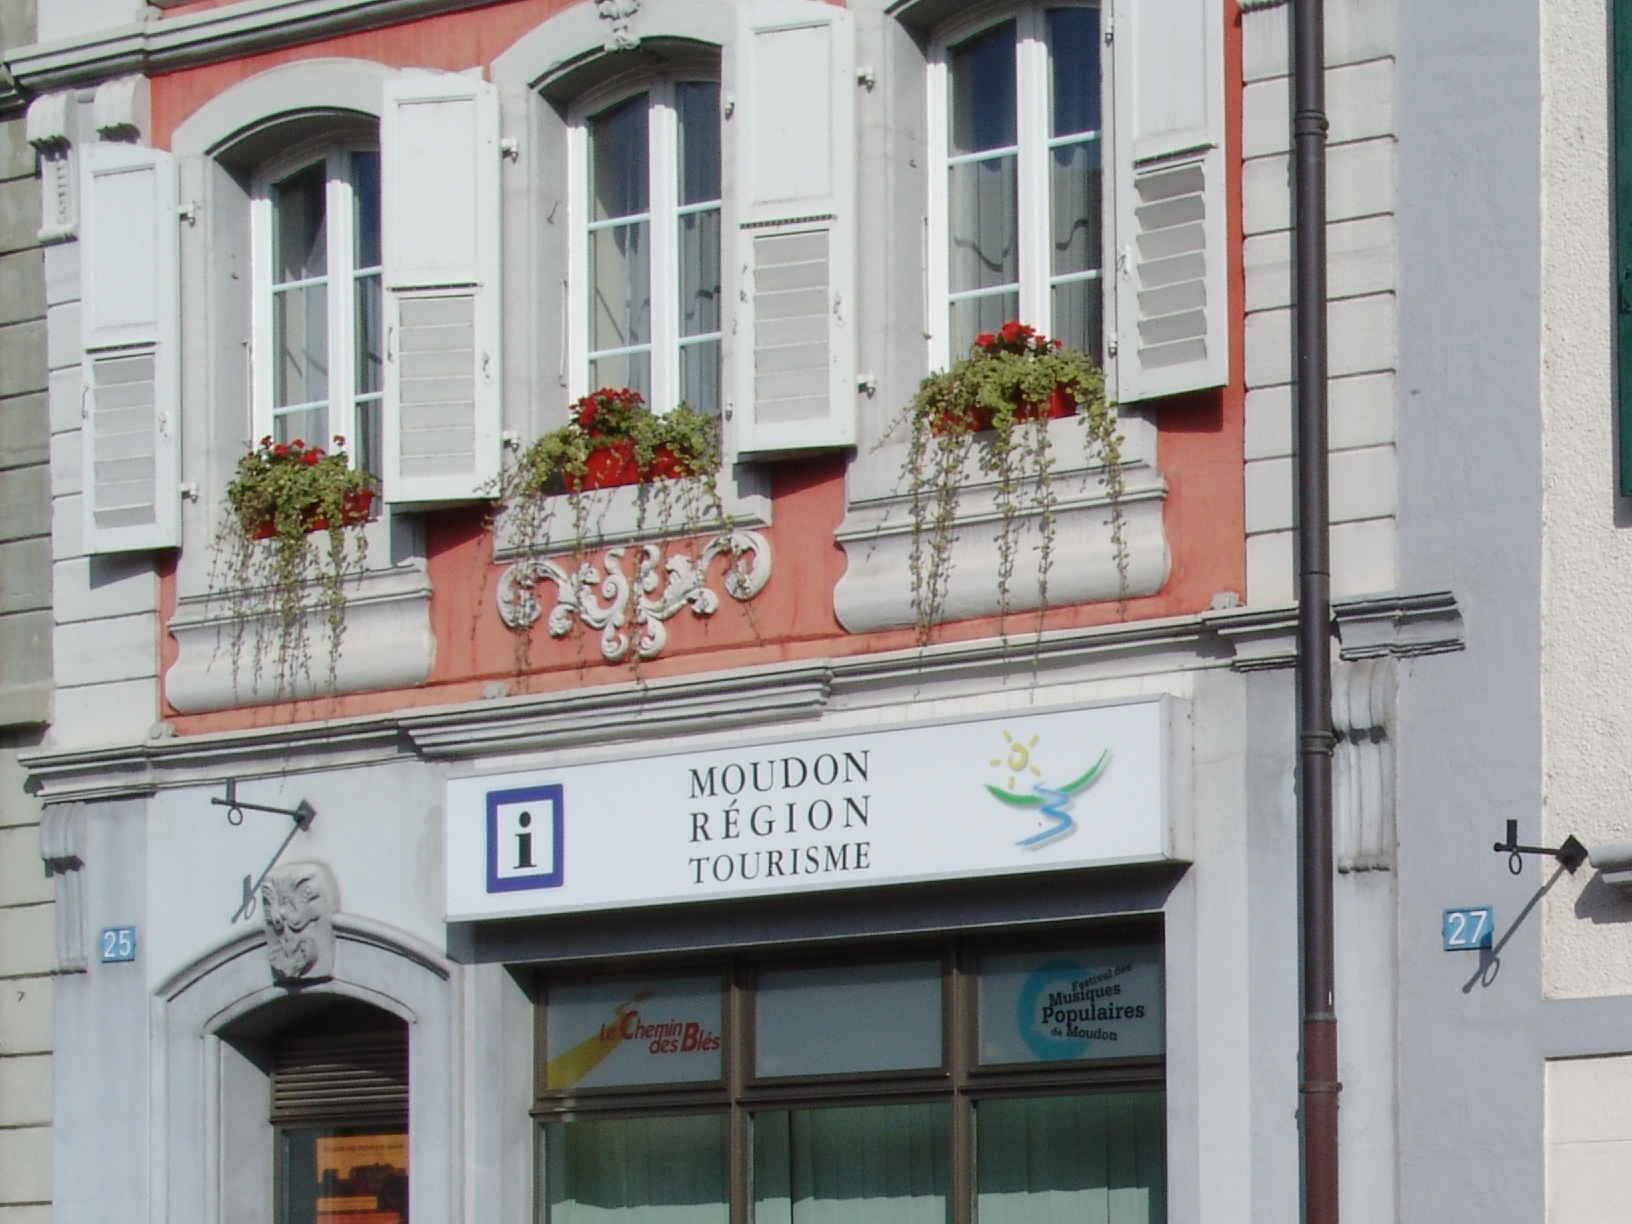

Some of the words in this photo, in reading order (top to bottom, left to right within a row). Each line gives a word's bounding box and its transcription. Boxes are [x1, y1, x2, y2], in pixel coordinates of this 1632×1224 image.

[688, 750, 870, 799] MOUDON
[689, 795, 871, 843] RÉGION
[513, 811, 537, 869] i
[688, 842, 870, 884] TOURISME
[1448, 910, 1487, 945] 27
[104, 930, 131, 957] 25
[1071, 969, 1112, 991] Festival
[1114, 964, 1132, 976] des
[1049, 983, 1121, 1006] Musiques
[599, 1023, 616, 1041] Le
[620, 1010, 683, 1039] Chemin
[1042, 1002, 1145, 1028] Populaires
[650, 1036, 678, 1054] des
[681, 1022, 720, 1052] Blés
[1051, 1027, 1062, 1036] de
[1066, 1026, 1118, 1041] Moudon
